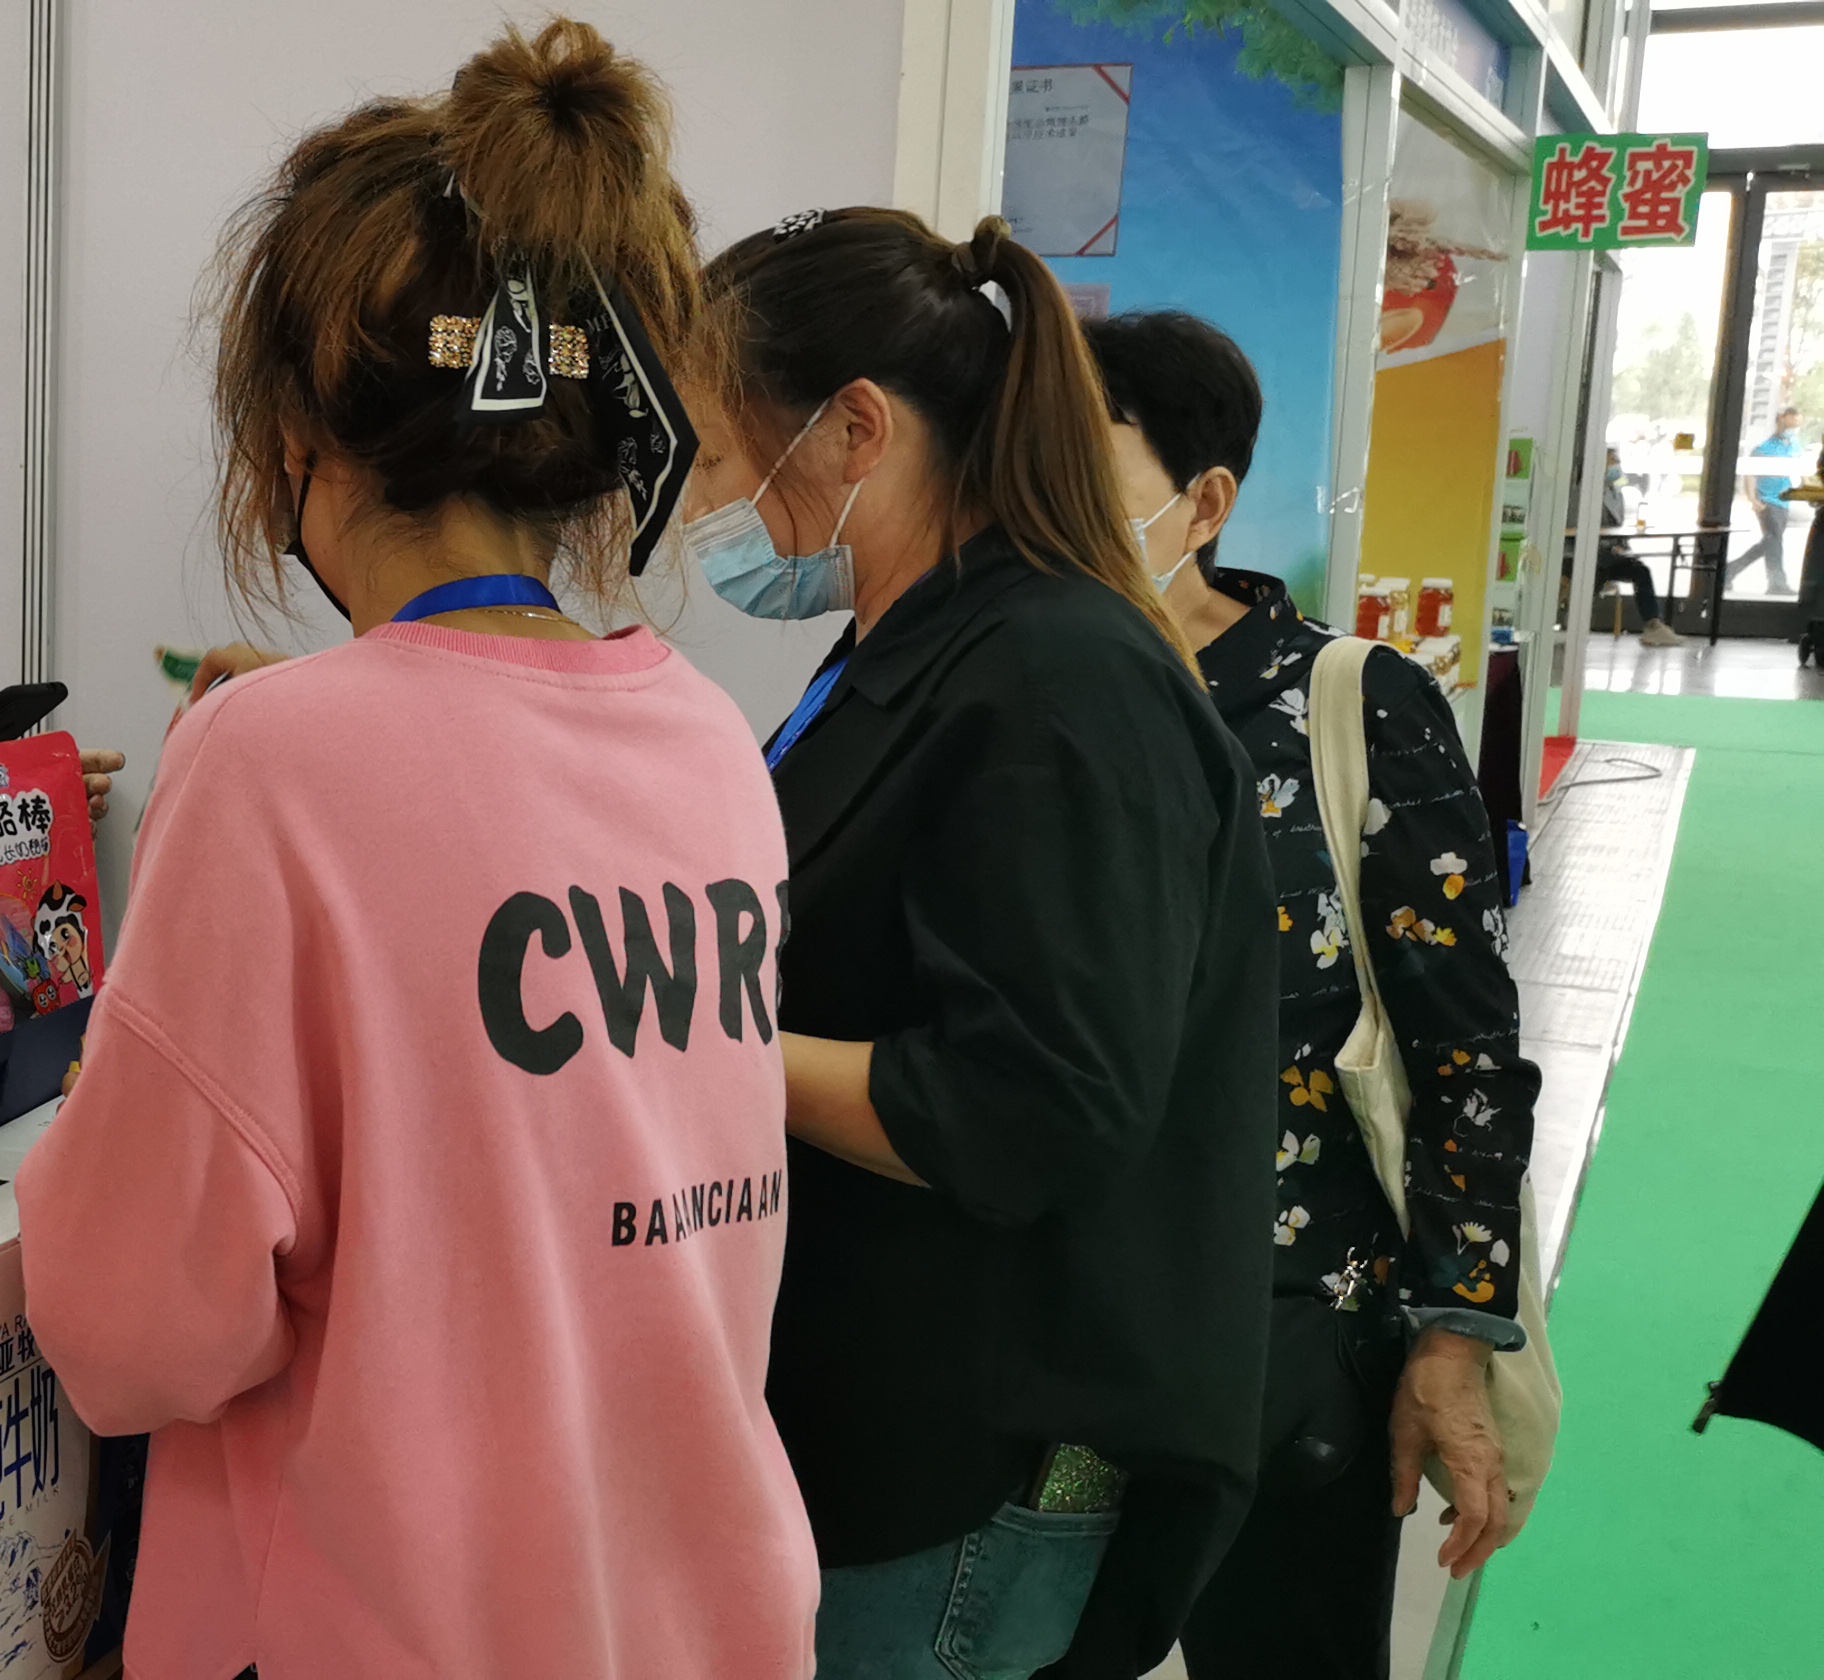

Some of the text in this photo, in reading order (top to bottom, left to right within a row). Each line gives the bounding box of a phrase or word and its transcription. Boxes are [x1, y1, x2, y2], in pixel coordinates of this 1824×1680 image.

[1536, 140, 1697, 242] 蜂蜜
[478, 878, 790, 1076] CWR
[25, 1484, 60, 1513] MILK
